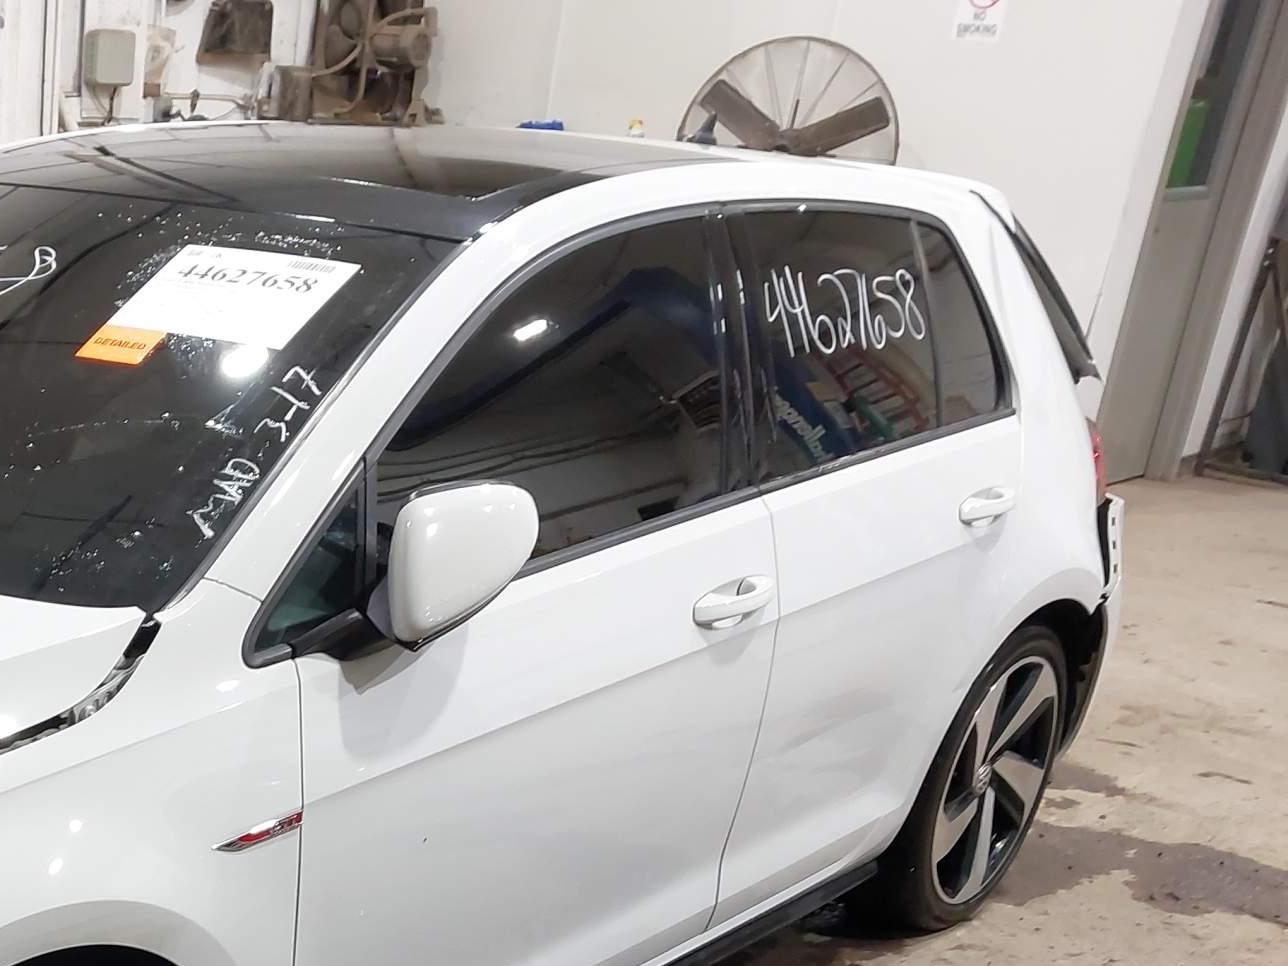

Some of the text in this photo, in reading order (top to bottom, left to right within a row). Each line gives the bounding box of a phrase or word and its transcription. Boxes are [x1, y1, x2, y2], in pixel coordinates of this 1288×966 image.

[972, 11, 987, 22] NO
[956, 23, 998, 37] SMOKING
[177, 263, 318, 294] 44627658
[763, 265, 926, 359] 44627658
[92, 336, 147, 351] DETAILED
